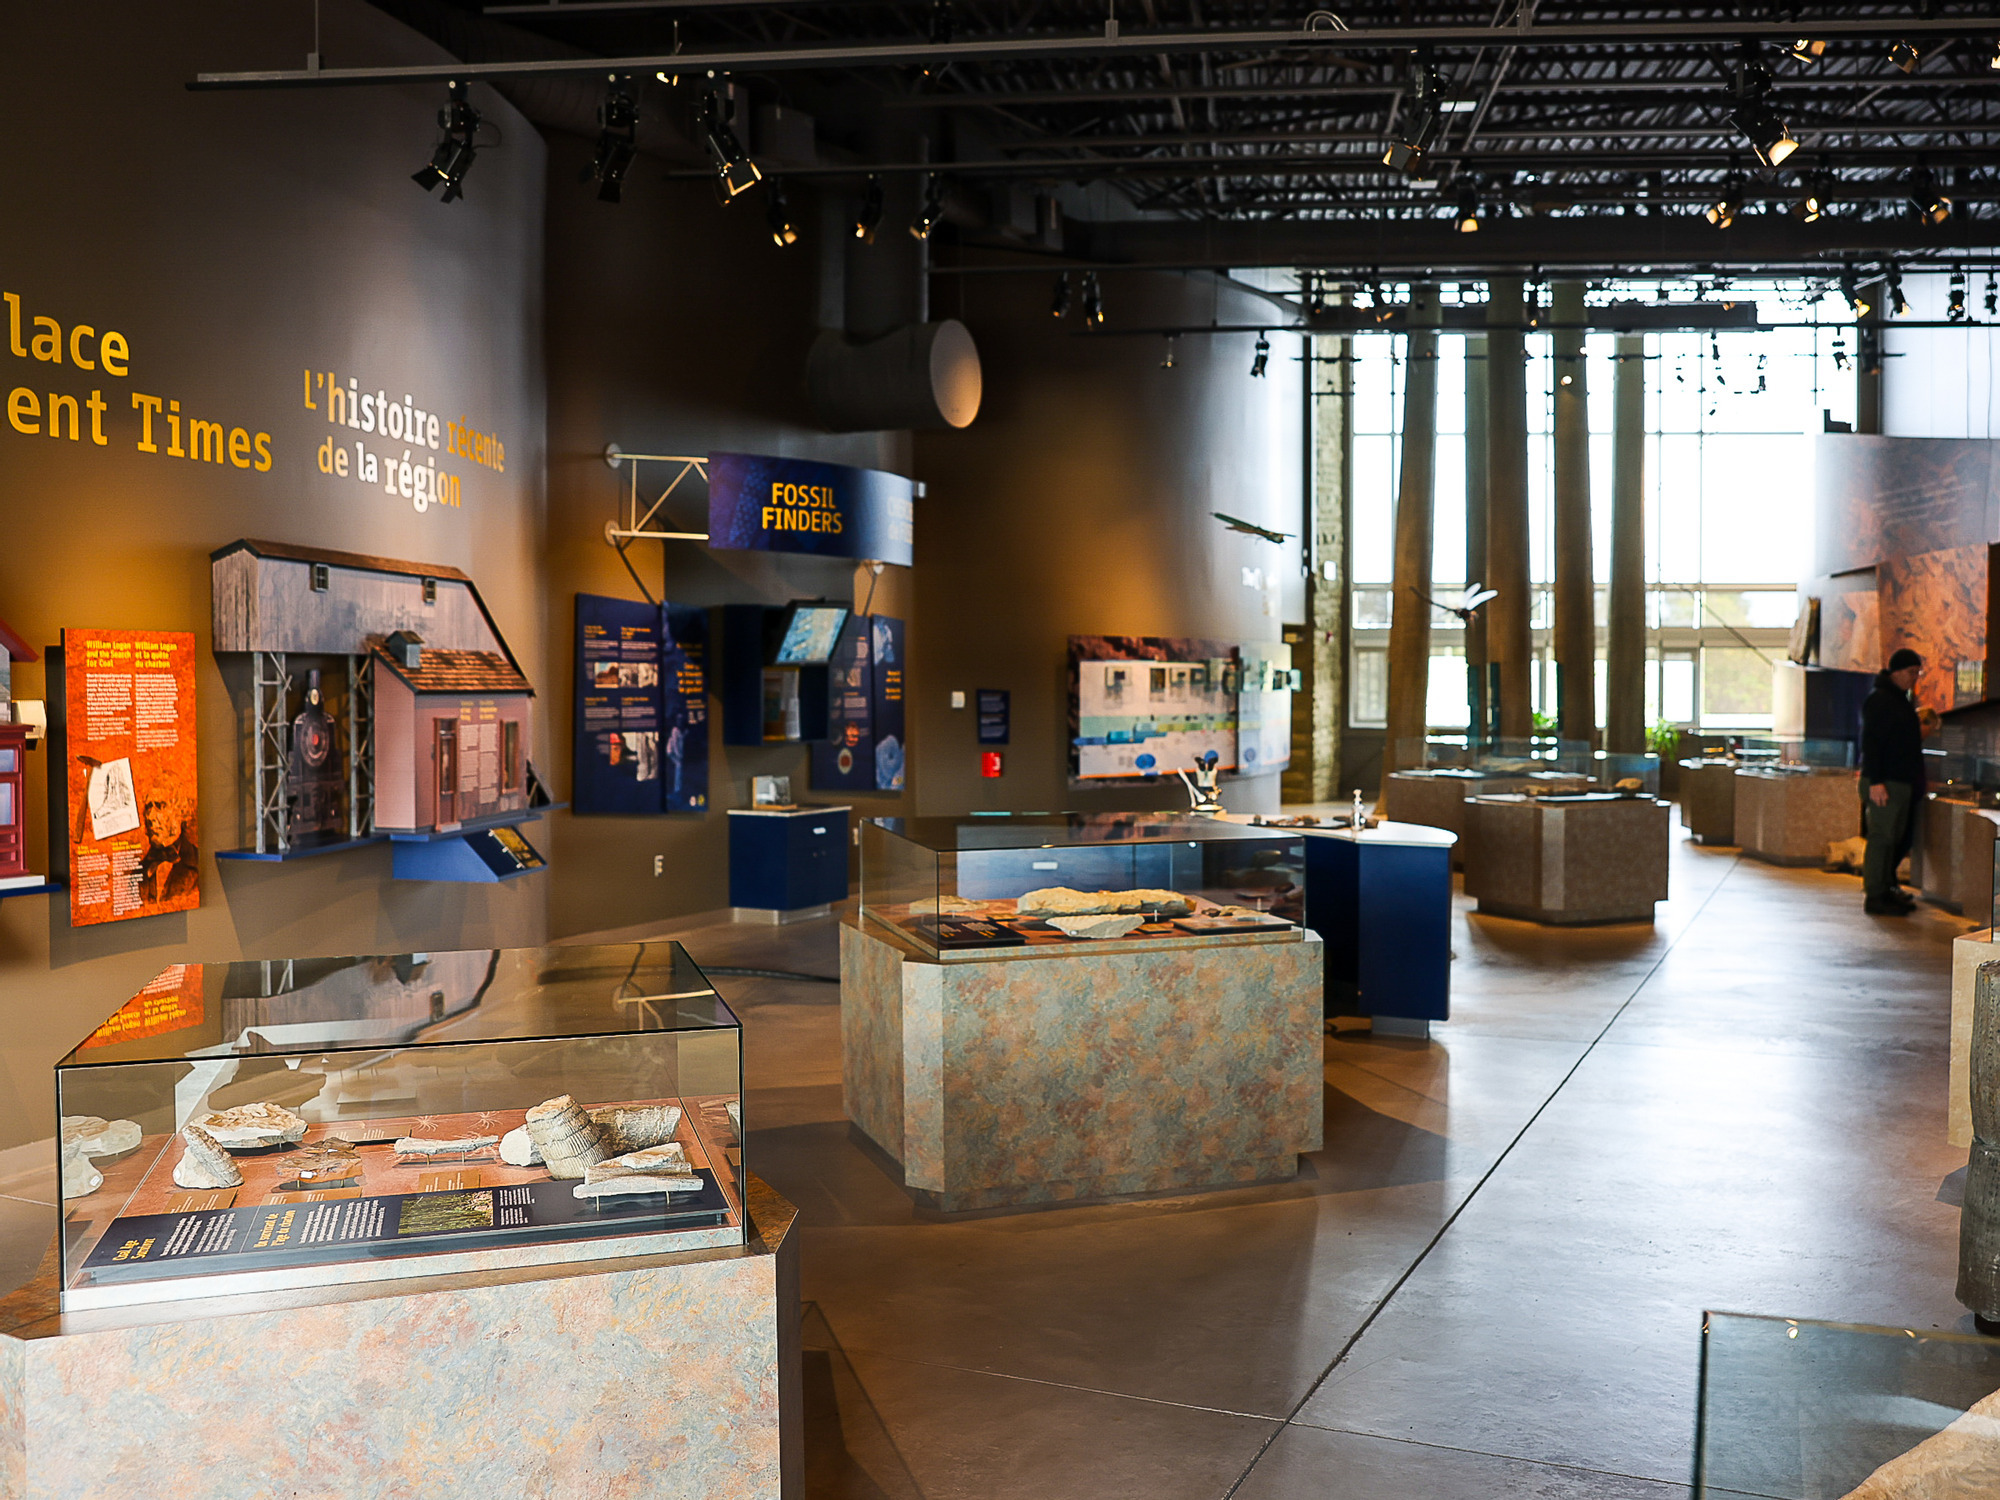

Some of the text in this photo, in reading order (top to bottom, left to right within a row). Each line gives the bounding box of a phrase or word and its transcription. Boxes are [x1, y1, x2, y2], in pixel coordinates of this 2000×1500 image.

[3, 291, 130, 377] lace
[6, 386, 273, 473] ent Times
[304, 369, 505, 474] L'histoire récente
[318, 436, 461, 513] de la région
[772, 482, 836, 509] FOSSIL
[762, 506, 843, 534] FINDERS
[86, 640, 131, 651] William Logan
[135, 641, 159, 650] William
